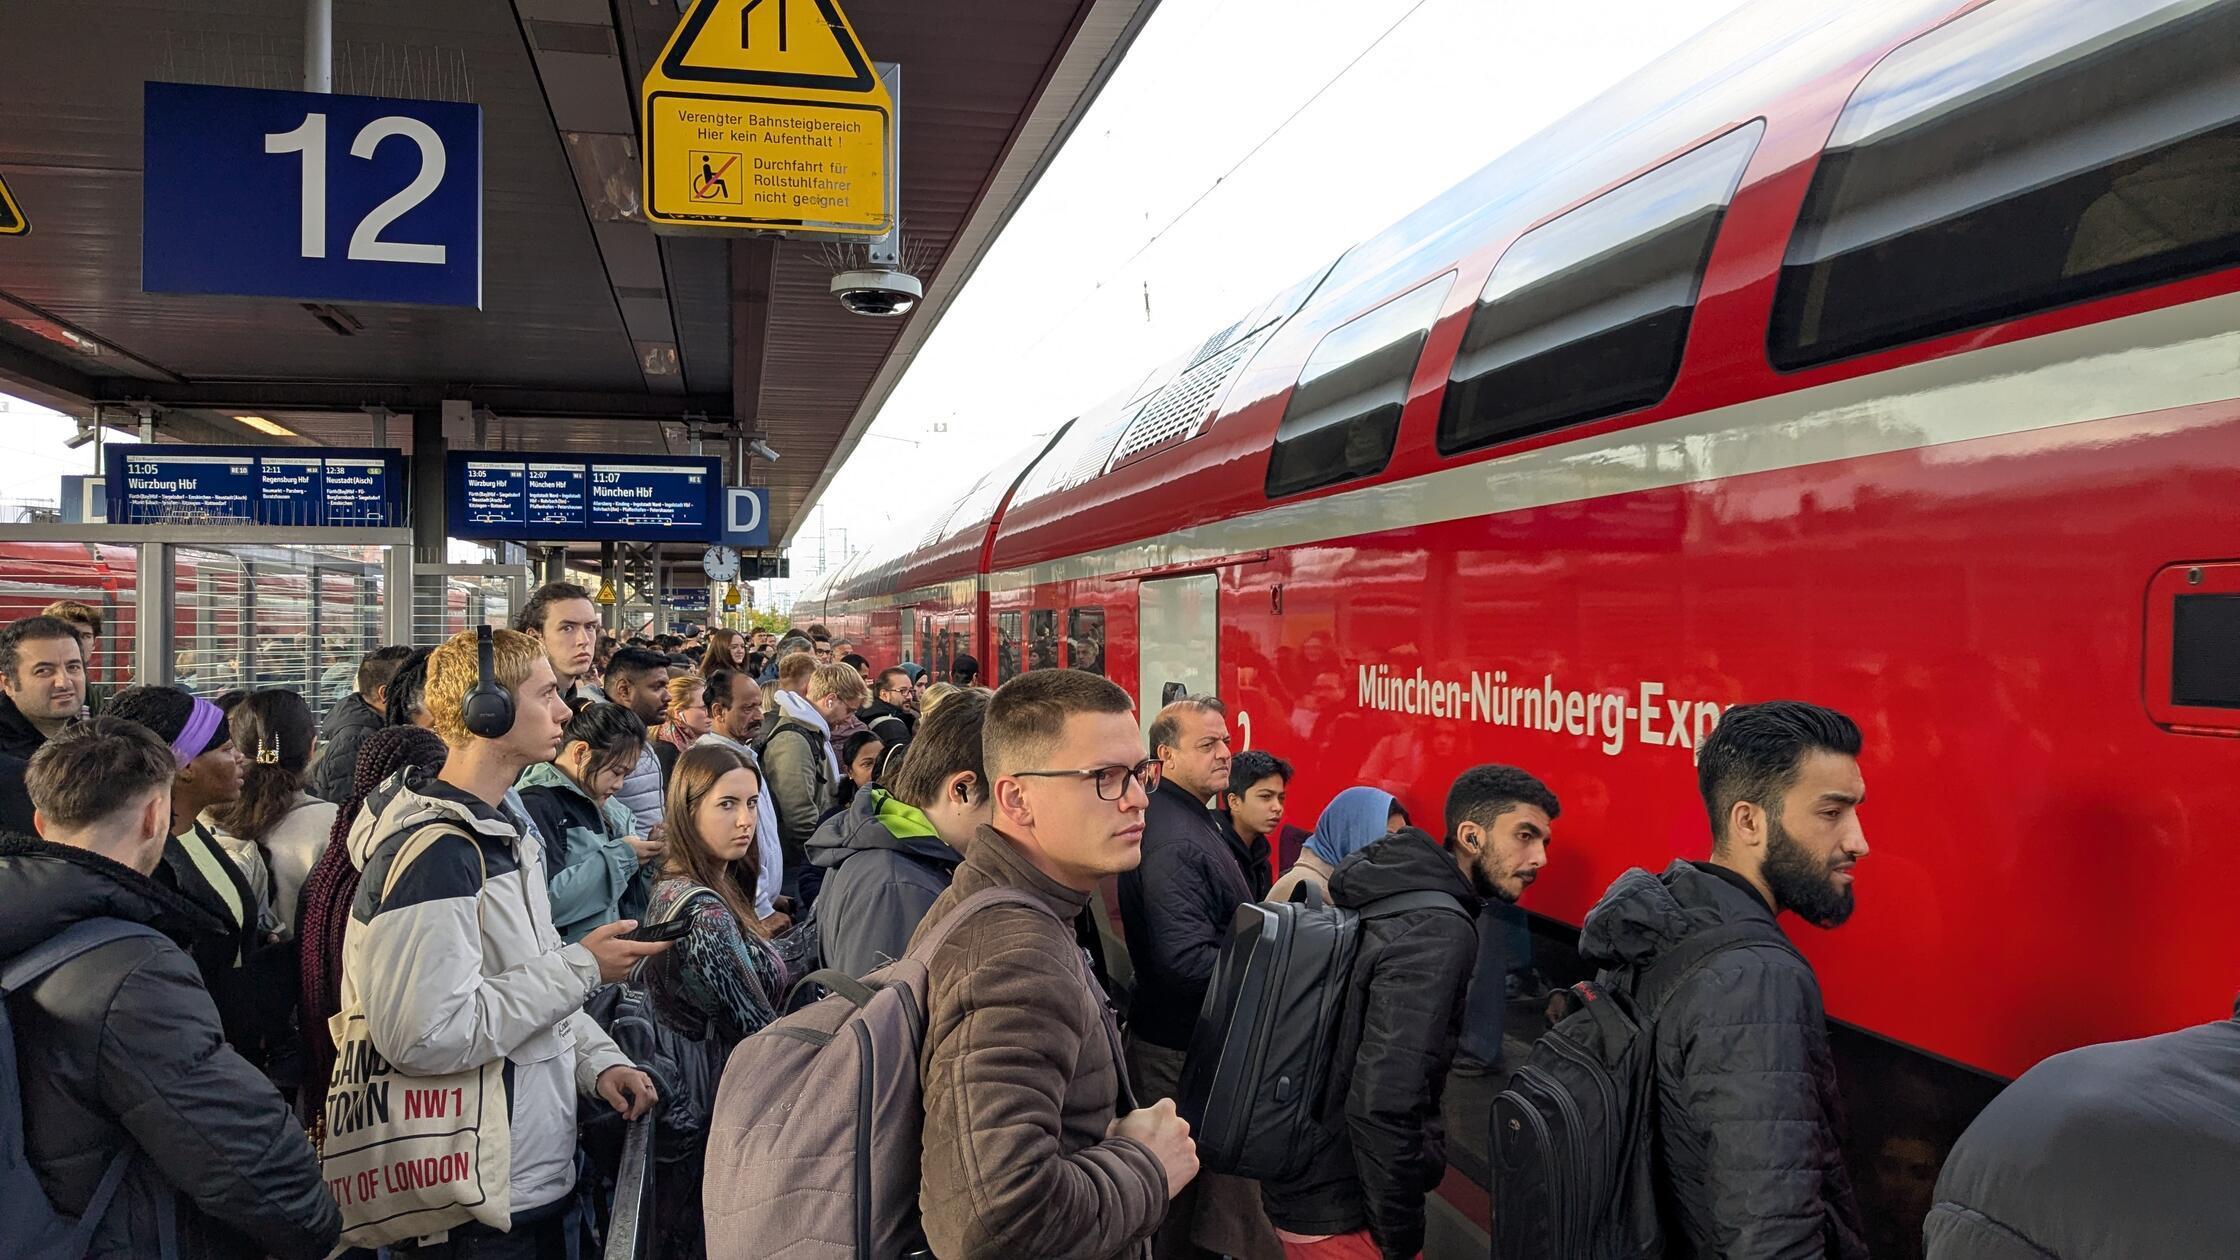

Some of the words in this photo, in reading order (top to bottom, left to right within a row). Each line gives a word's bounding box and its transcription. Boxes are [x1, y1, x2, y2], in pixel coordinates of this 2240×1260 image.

[678, 110, 742, 128] Verengter
[750, 115, 860, 132] Bahnsteigbereich
[698, 128, 724, 140] Hier
[731, 130, 756, 141] kein
[764, 132, 832, 147] Aufenthalt
[754, 158, 823, 172] Durchfahrt
[831, 163, 848, 174] für
[265, 113, 446, 264] 12
[754, 174, 851, 190] Rollstuhlfahrer
[755, 191, 786, 203] nicht
[128, 464, 158, 474] 11:05
[128, 478, 176, 491] Würzburg
[179, 479, 197, 489] Hbf
[593, 474, 620, 482] 11:07
[593, 486, 634, 497] München
[636, 487, 652, 497] Hbf
[728, 489, 761, 532] D
[1358, 664, 1735, 767] München-Nürnberg-Exp
[326, 1081, 389, 1138] TOWN
[405, 1088, 462, 1120] NW1
[324, 1176, 352, 1207] ITY
[358, 1168, 378, 1201] OF
[384, 1152, 468, 1194] LONDON
